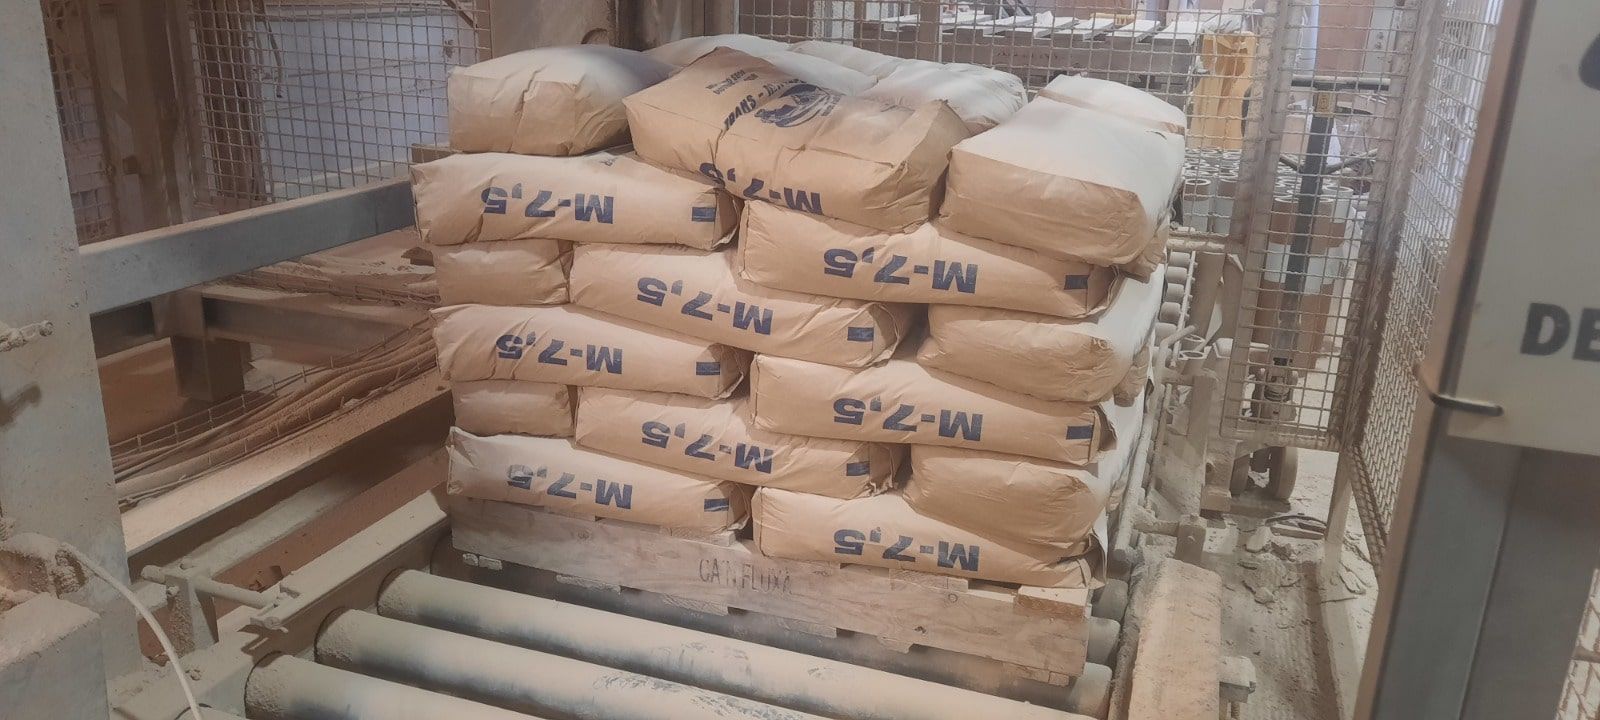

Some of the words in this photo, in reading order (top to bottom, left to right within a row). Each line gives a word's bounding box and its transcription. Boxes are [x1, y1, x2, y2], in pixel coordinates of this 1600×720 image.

[480, 185, 614, 224] M-7,5
[824, 247, 978, 294] M-7,5
[636, 277, 773, 336] M-7,5
[495, 333, 623, 374] M-7,5
[832, 397, 983, 441] M-7,5
[641, 421, 774, 473] M-7,5
[507, 464, 633, 509] M-7,5
[834, 528, 980, 571] M-7,5
